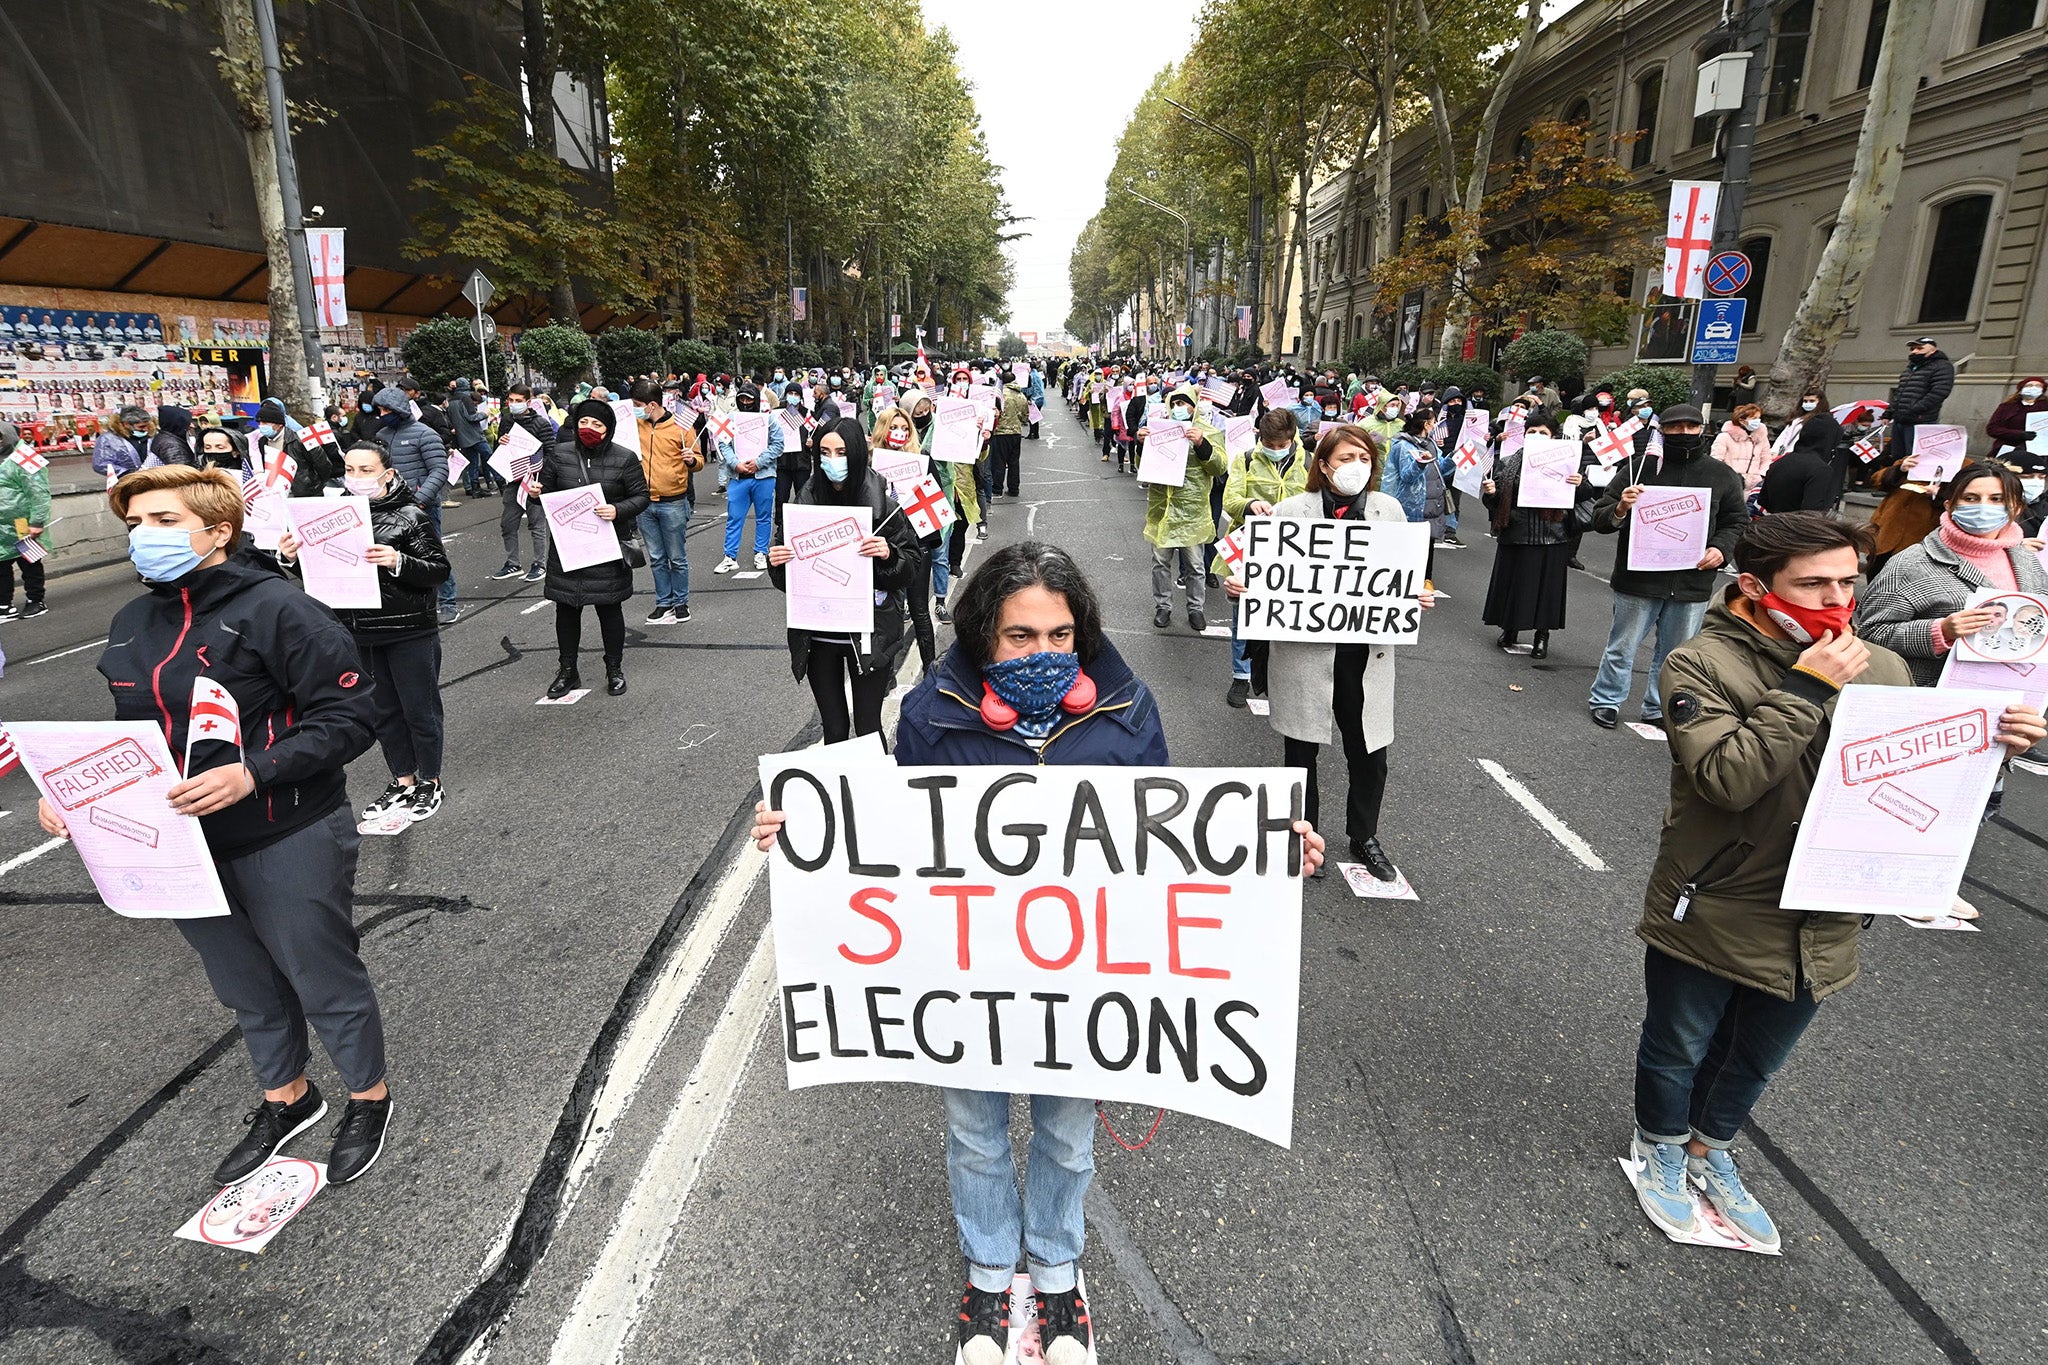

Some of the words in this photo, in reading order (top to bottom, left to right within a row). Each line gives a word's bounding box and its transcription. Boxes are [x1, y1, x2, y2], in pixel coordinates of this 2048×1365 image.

[305, 512, 353, 540] FALSIFIED
[557, 496, 593, 521] FALSIFIED
[1644, 499, 1694, 519] FALSIFIED
[798, 524, 855, 553] FALSIFIED
[1249, 520, 1371, 562] FREE
[1244, 562, 1418, 599] POLITICAL
[1244, 598, 1418, 634] PRISONERS
[1855, 722, 1977, 772] FALSIFIED
[55, 749, 142, 799] FALSIFIED
[769, 767, 1303, 880] OLIGARCH
[837, 884, 1232, 980] STOLE
[783, 982, 1268, 1097] ELECTIONS
